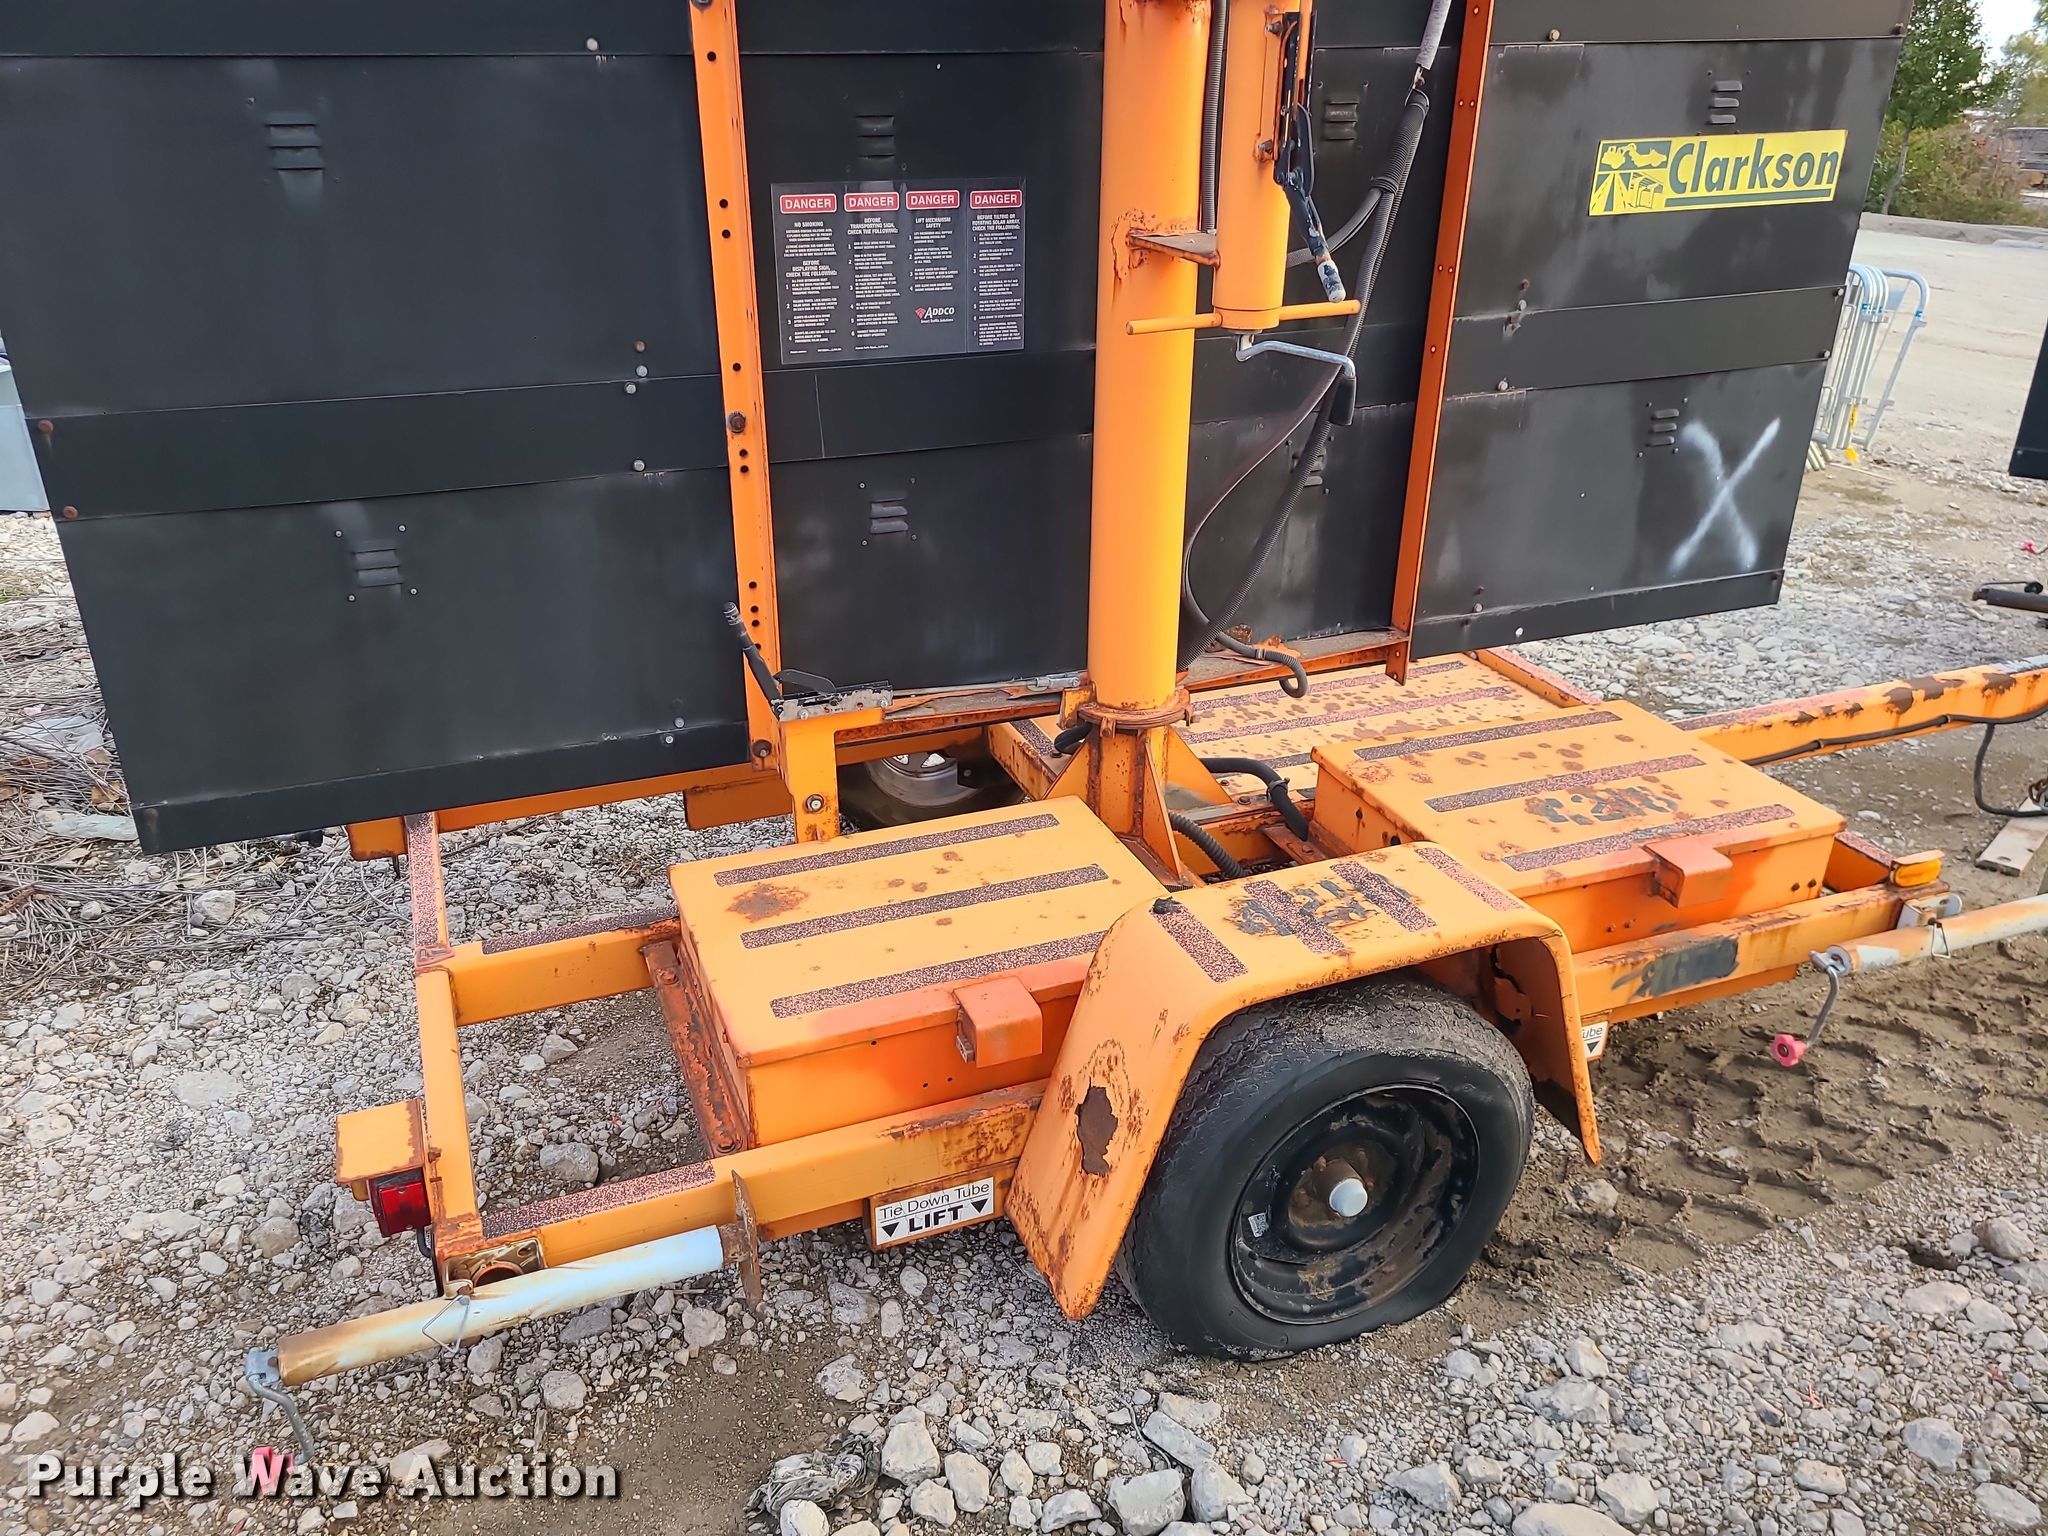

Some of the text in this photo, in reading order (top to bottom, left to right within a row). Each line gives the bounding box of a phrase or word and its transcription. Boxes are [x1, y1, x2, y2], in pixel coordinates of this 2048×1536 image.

[1669, 138, 1840, 194] Clarkson
[785, 198, 832, 209] DANGER
[849, 196, 894, 208] DANGER
[910, 194, 955, 206] DANGER
[974, 194, 1018, 205] DANGER
[923, 306, 955, 319] ADDCO
[1582, 1027, 1603, 1039] ube
[880, 1183, 990, 1219] Tie Down Tube
[908, 1204, 964, 1233] LIFT
